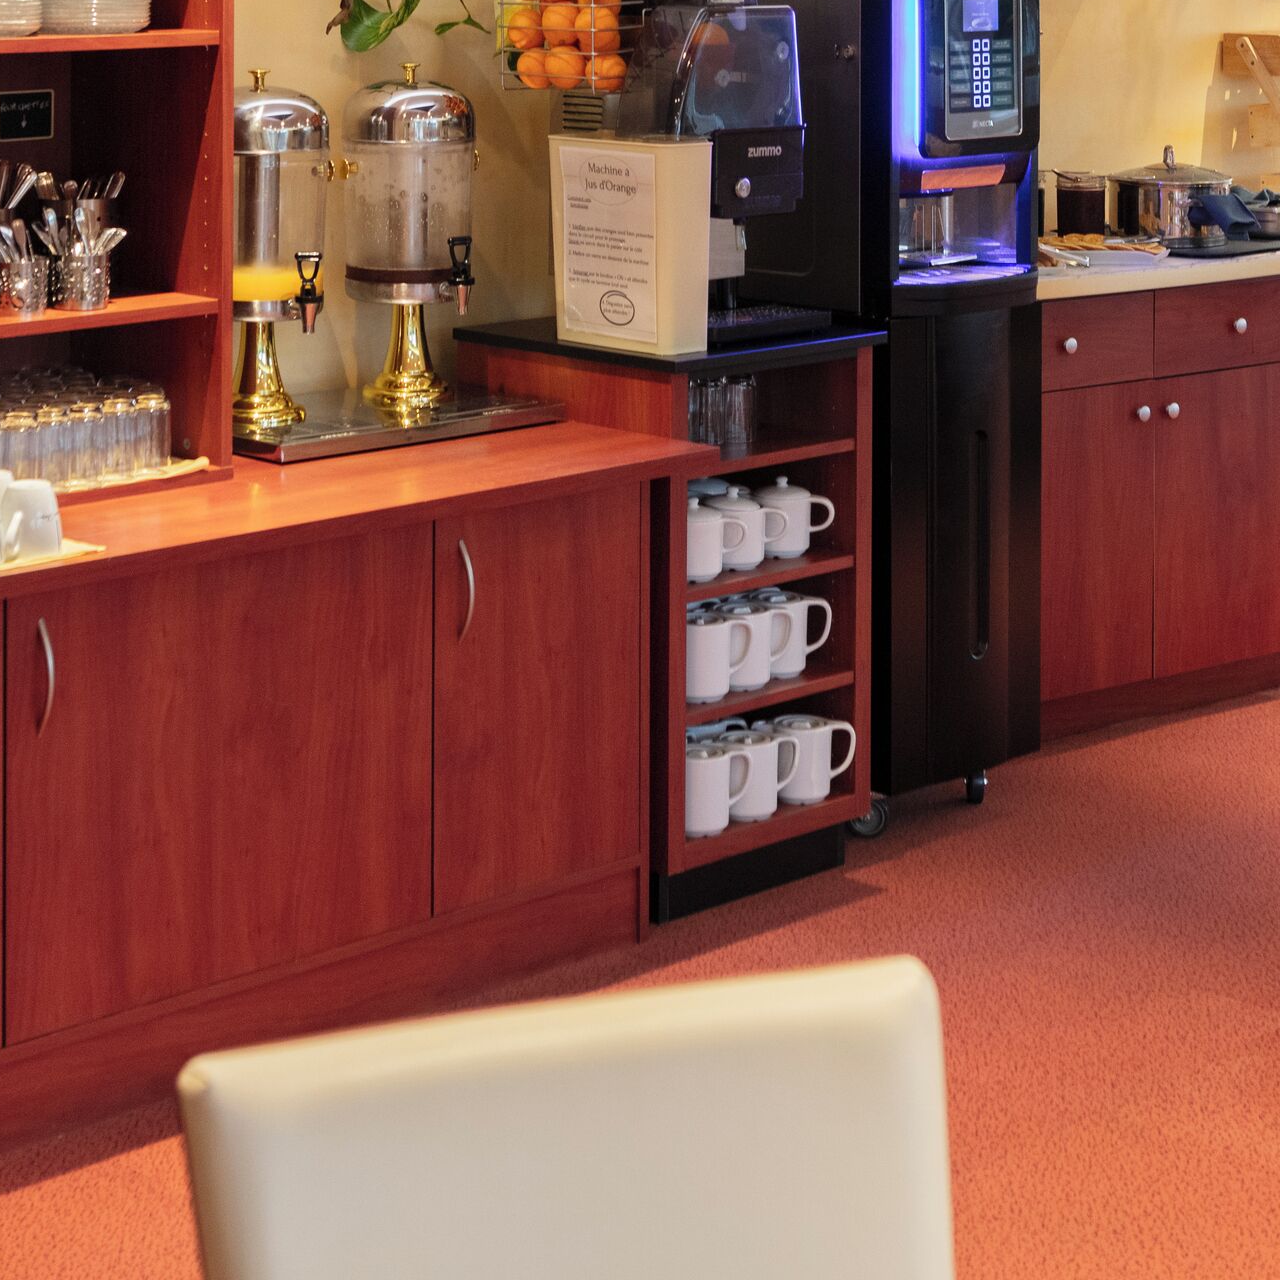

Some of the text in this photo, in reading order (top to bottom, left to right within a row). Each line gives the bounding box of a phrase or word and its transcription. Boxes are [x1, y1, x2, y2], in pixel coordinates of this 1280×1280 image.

[748, 146, 782, 158] zummo
[588, 162, 630, 177] Machine à
[585, 178, 637, 196] Jus d'Orange
